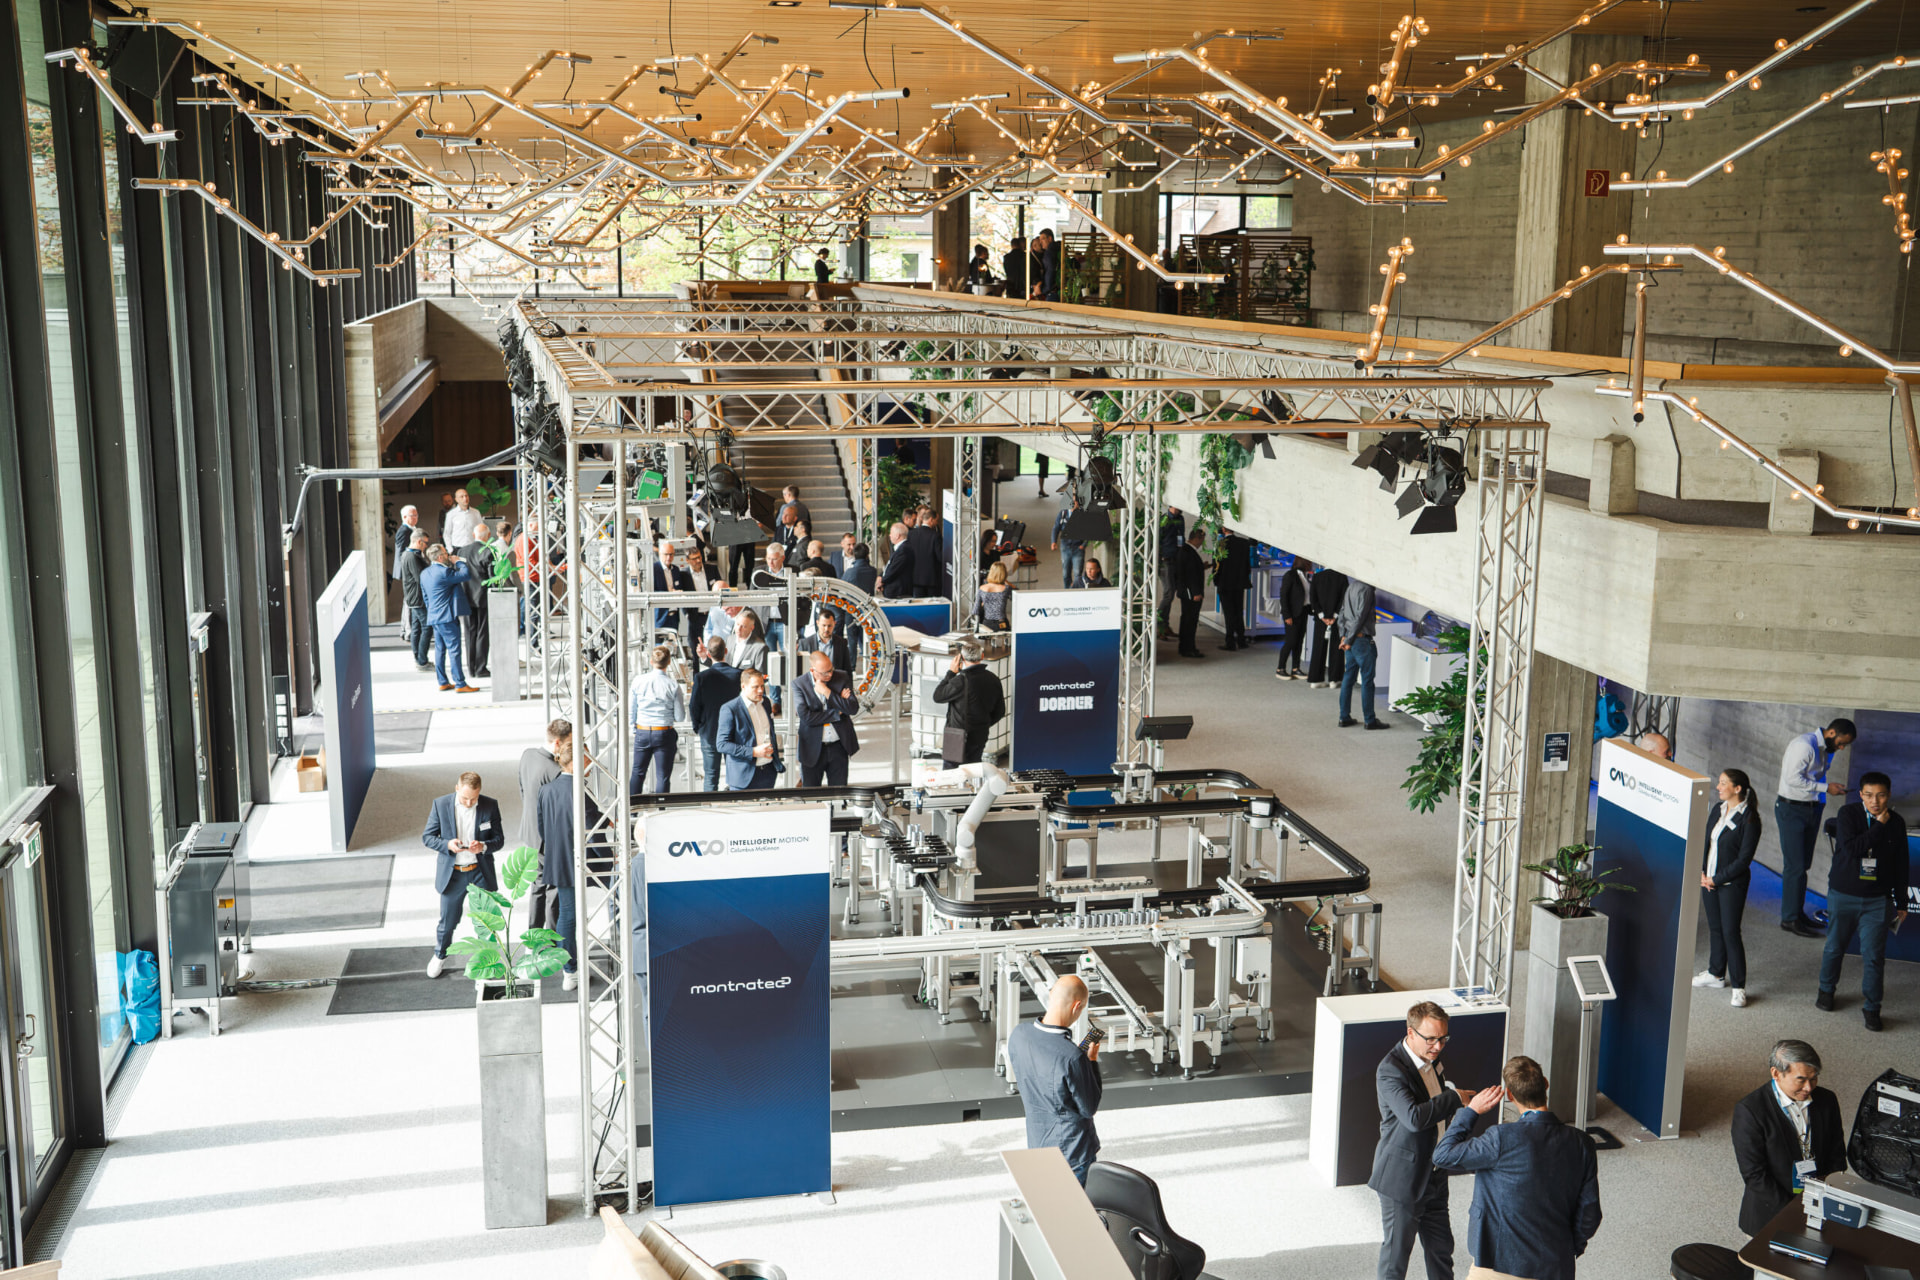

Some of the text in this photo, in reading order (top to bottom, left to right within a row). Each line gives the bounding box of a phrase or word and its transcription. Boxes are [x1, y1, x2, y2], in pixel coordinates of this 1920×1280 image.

[1040, 681, 1095, 691] montratec
[1039, 696, 1094, 712] DORNER
[729, 836, 810, 846] INTELLIGENT MOTION
[690, 976, 792, 994] montratec
